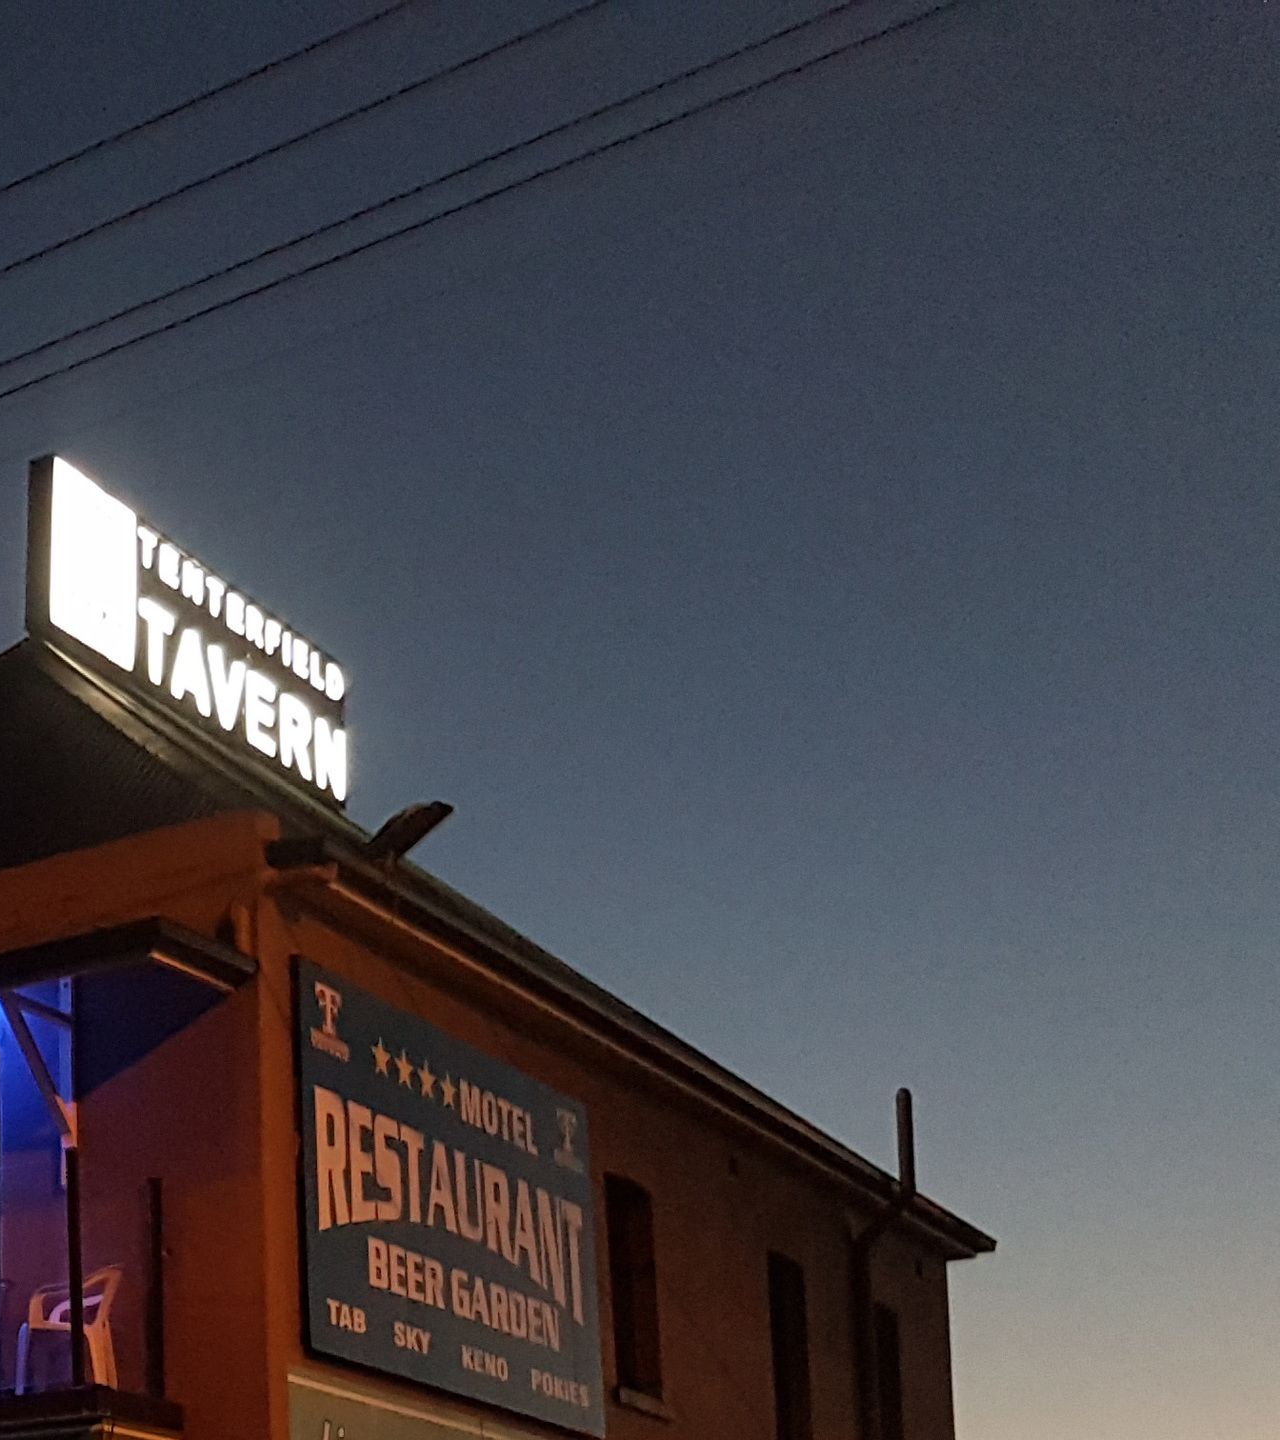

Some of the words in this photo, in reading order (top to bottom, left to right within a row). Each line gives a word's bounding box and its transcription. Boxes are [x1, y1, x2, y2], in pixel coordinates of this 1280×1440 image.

[137, 525, 345, 701] TENTERFIELD
[138, 597, 347, 802] TAVERN
[459, 1078, 539, 1157] MOTEL
[314, 1084, 584, 1327] RESTAURANT
[326, 1299, 367, 1334] TAB
[393, 1321, 432, 1356] SKY
[461, 1344, 508, 1382] KENO
[531, 1367, 590, 1409] POKIES
[367, 1236, 445, 1310] BEER
[451, 1267, 561, 1353] GARDEN
